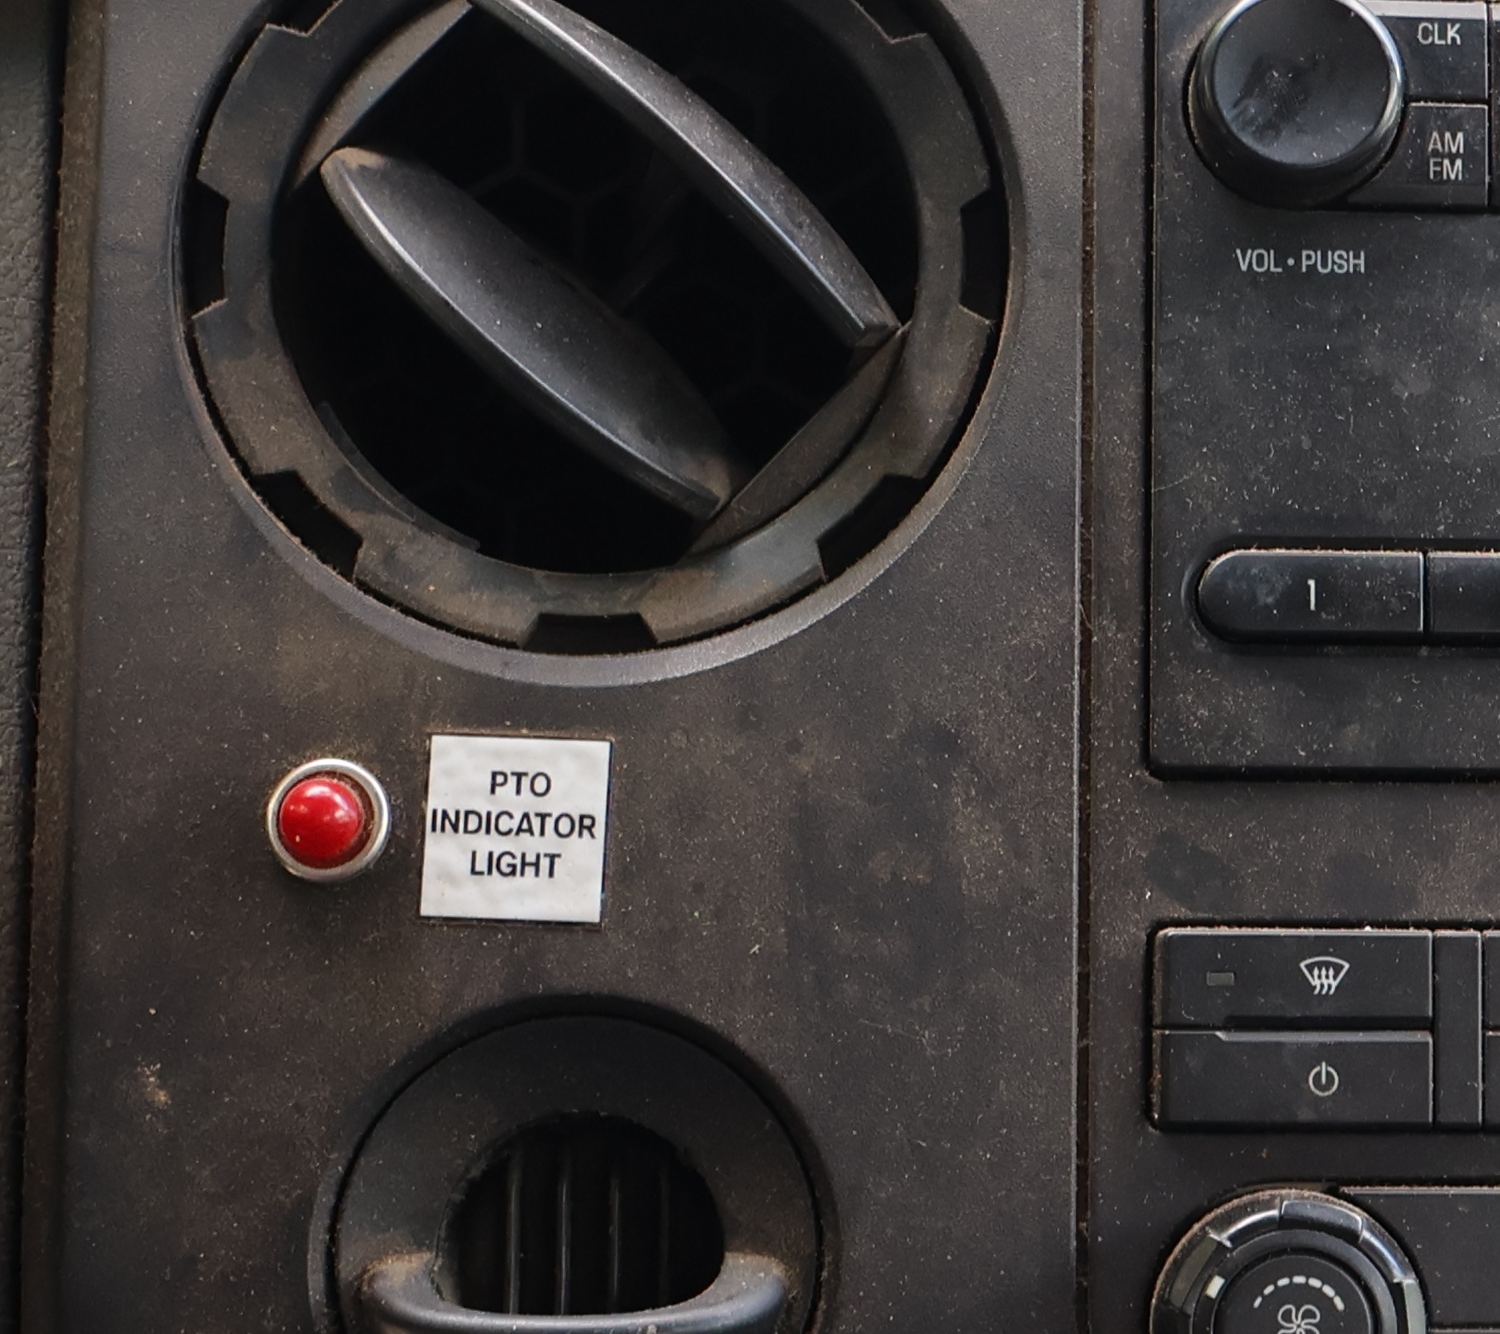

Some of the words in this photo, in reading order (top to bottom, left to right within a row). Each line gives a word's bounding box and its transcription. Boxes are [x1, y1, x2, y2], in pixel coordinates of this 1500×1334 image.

[1417, 23, 1462, 46] CLK
[1428, 132, 1464, 154] AM
[1429, 159, 1462, 181] FM
[1301, 250, 1365, 273] PUSH
[1307, 579, 1317, 610] 1
[490, 771, 552, 796] PTO
[430, 808, 597, 839] INDICATOR
[470, 851, 562, 879] LIGHT
